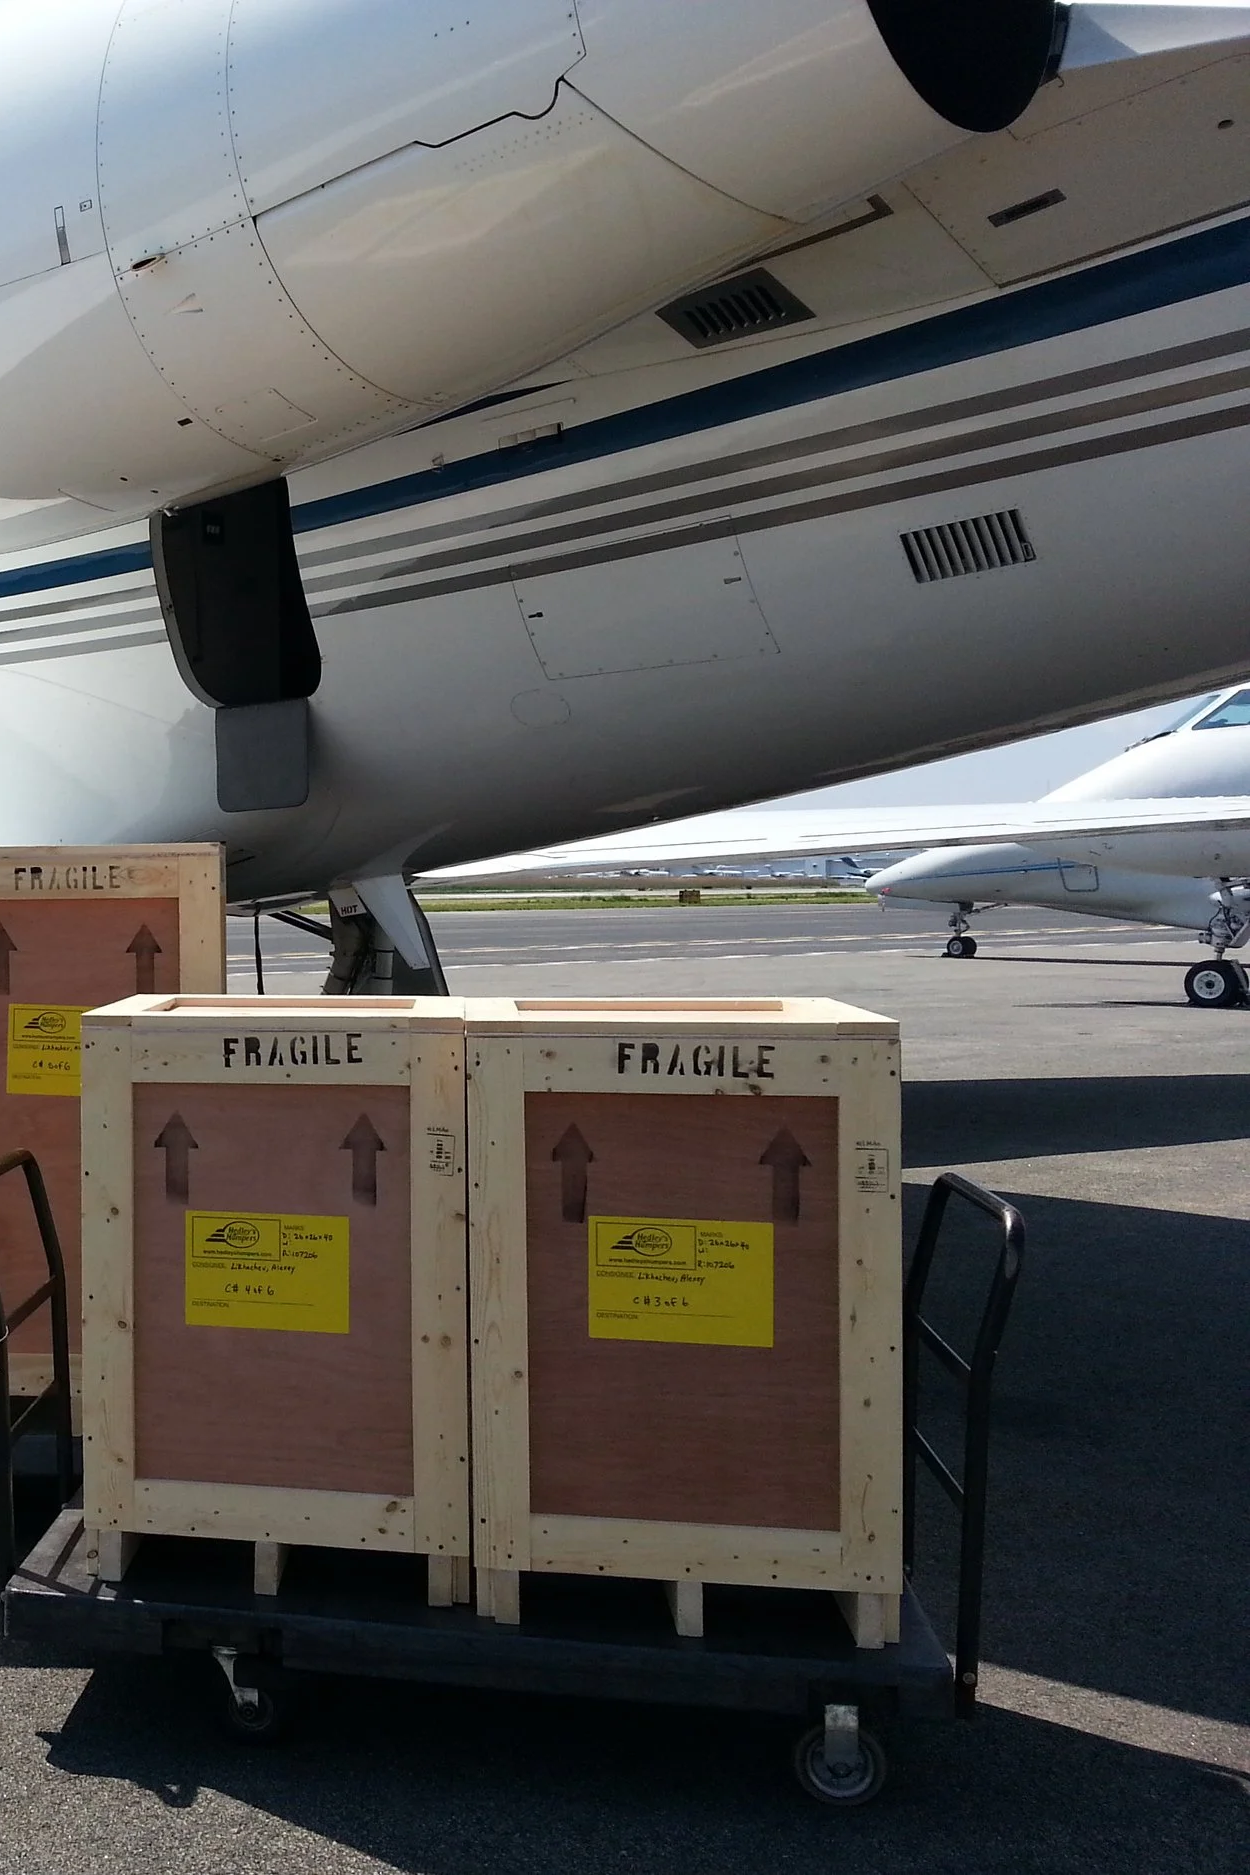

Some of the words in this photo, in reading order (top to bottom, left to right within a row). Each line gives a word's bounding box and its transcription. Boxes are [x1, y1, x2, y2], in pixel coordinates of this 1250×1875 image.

[14, 865, 121, 891] FRAGILE
[341, 905, 358, 915] HOT
[223, 1033, 363, 1068] FRAGILE
[617, 1042, 776, 1079] FRAGILE
